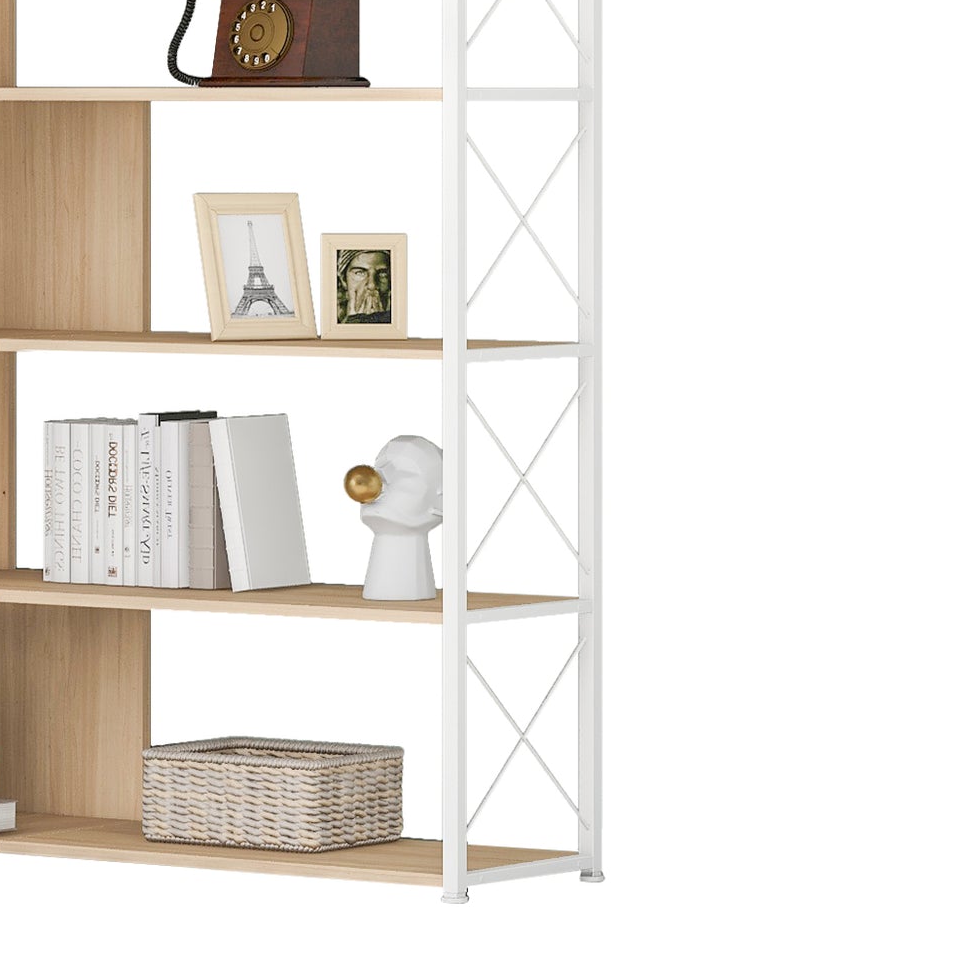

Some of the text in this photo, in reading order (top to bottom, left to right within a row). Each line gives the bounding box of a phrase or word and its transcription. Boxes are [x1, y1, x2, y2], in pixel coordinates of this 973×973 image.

[250, 3, 256, 13] 3
[260, 0, 266, 10] 2
[271, 3, 276, 12] 1
[241, 11, 247, 20] 4
[235, 23, 241, 32] 5
[234, 35, 240, 44] 6
[237, 46, 243, 55] 7
[244, 54, 250, 63] 8
[254, 56, 260, 65] 9
